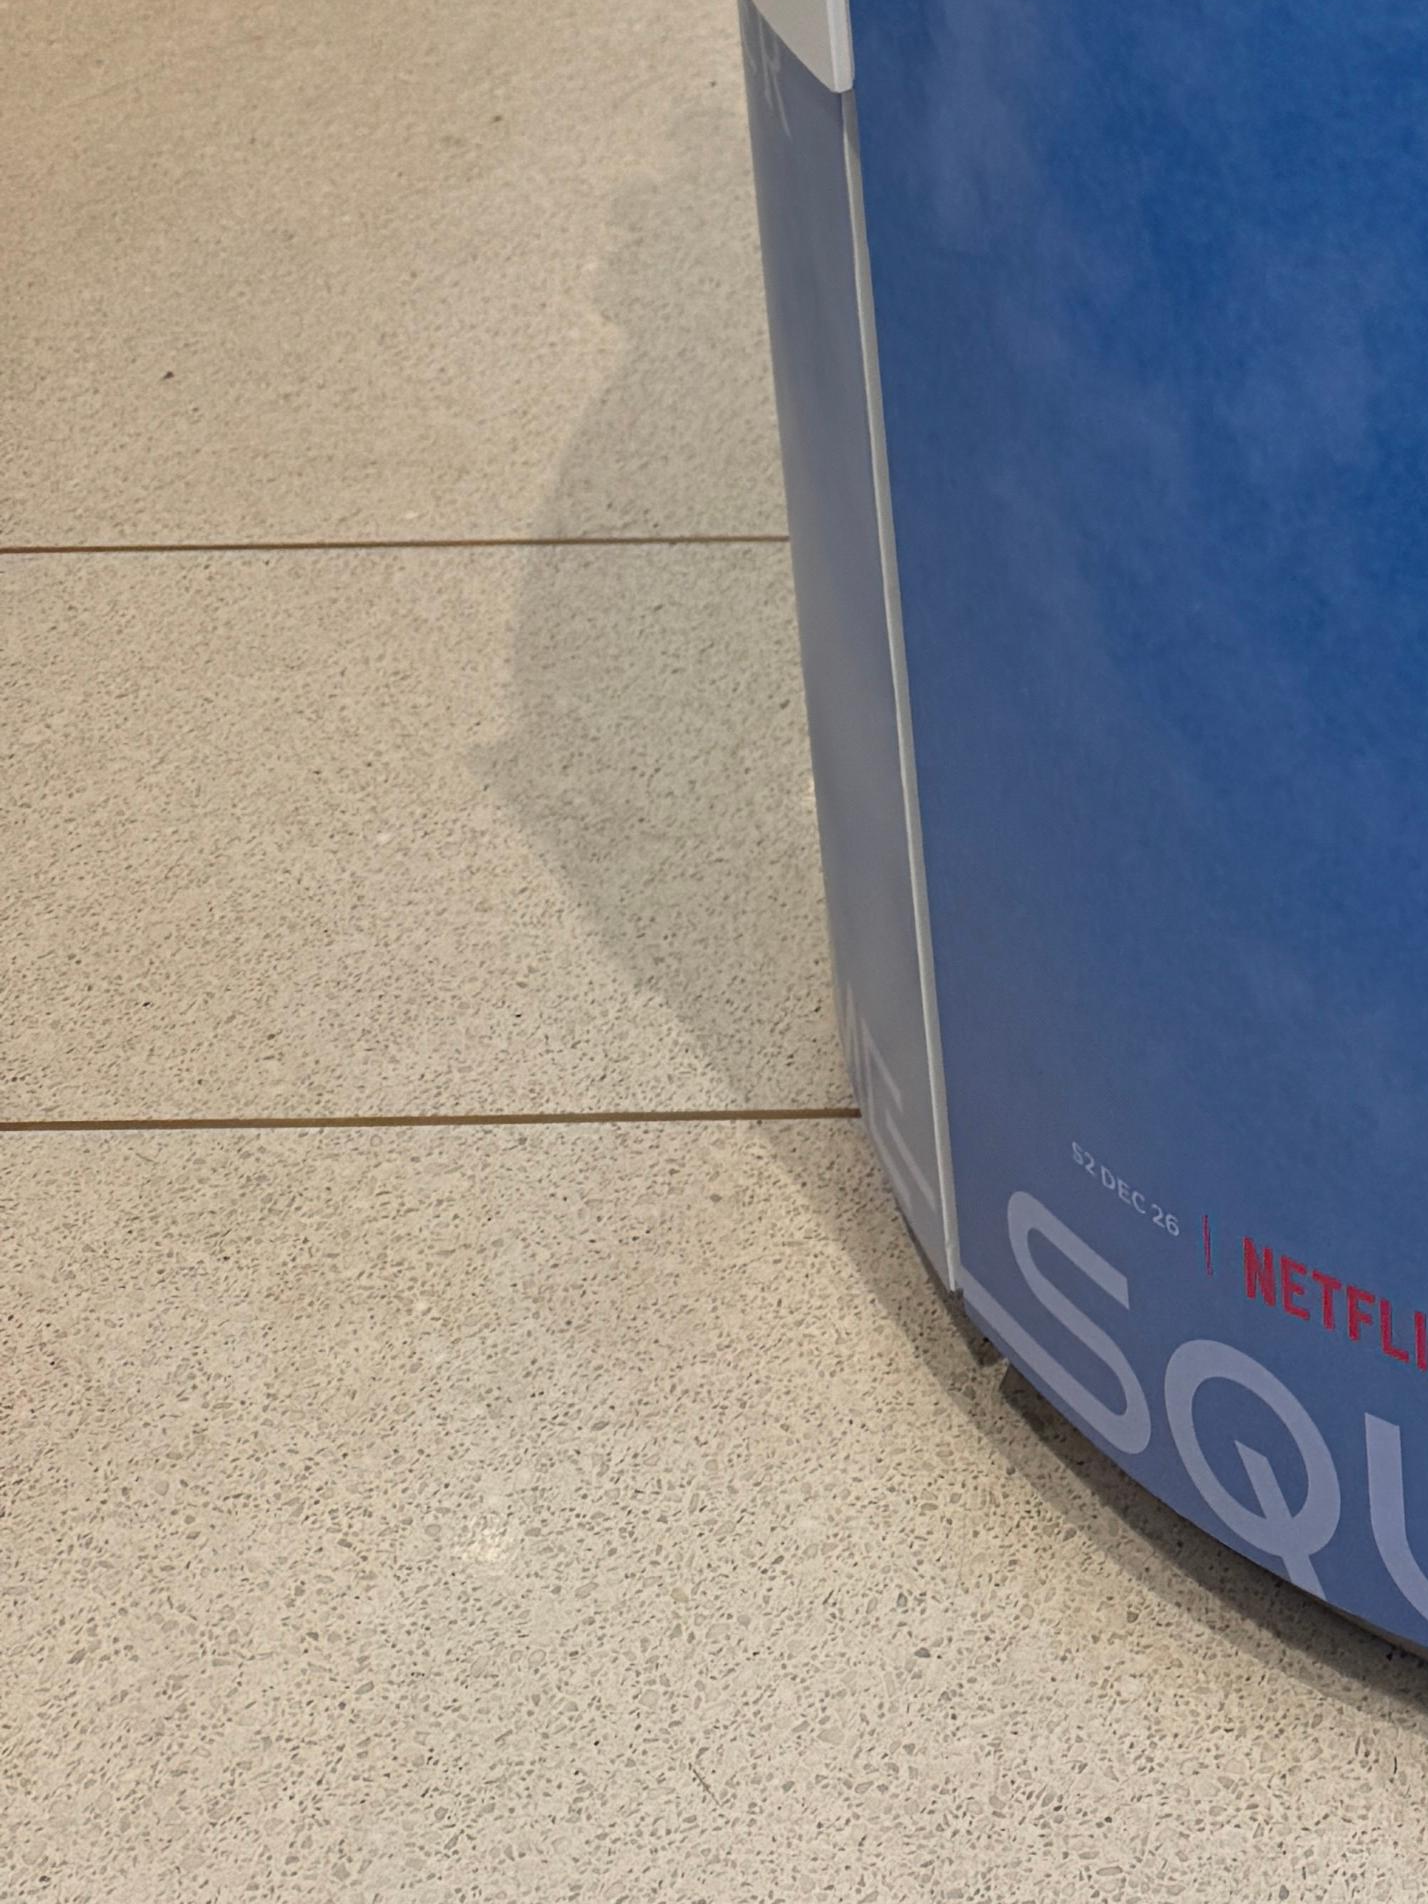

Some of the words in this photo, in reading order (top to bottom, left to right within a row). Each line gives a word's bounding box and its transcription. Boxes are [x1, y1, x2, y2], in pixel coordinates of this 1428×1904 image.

[1071, 1140, 1096, 1177] S2
[1099, 1165, 1147, 1215] DEC
[1150, 1202, 1182, 1238] 26
